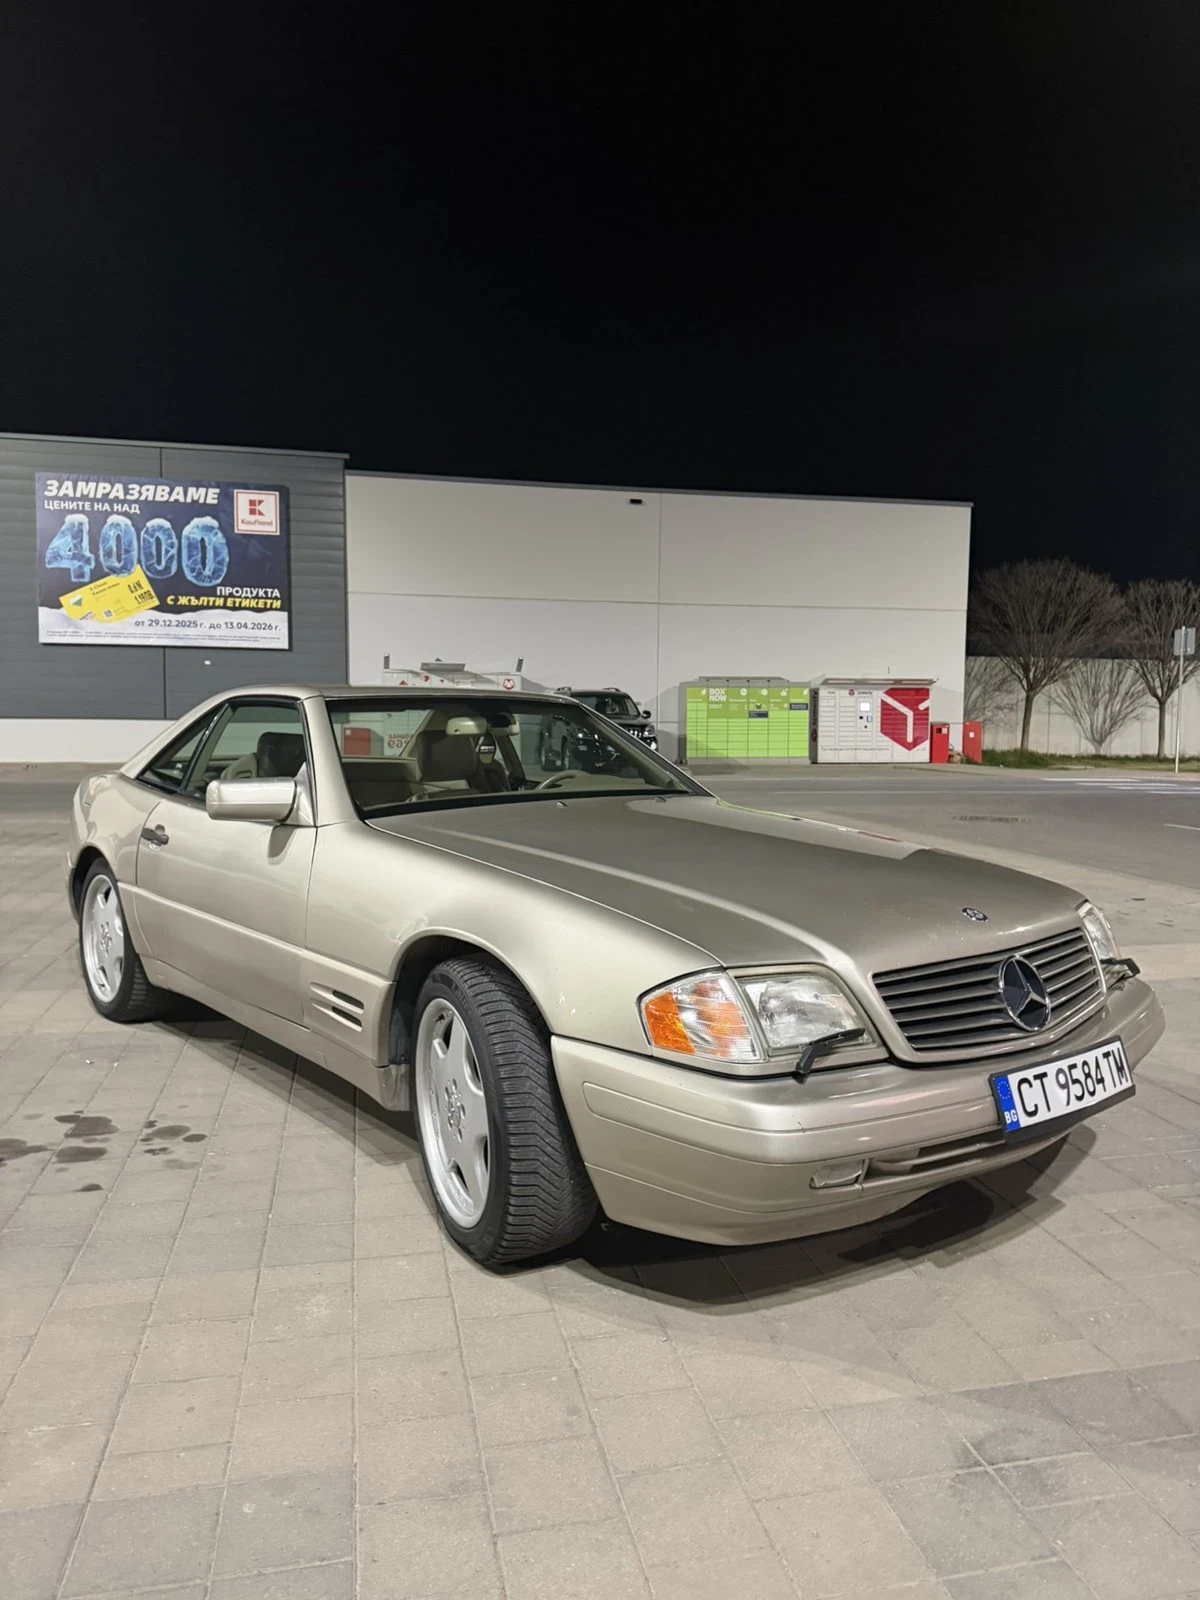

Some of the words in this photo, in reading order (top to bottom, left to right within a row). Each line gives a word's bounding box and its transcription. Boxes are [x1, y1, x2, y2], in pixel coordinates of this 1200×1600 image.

[44, 480, 220, 504] ЗАМРАЗЯВАМЕ
[44, 500, 92, 512] ЦЕНИТЕ
[94, 502, 111, 512] НА
[113, 503, 140, 514] НАД
[46, 514, 229, 586] 4000
[216, 586, 281, 598] ПРОДУКТА
[167, 595, 174, 605] С
[177, 596, 221, 607] ЖЪЛТИ
[226, 597, 281, 609] ЕТИКЕТИ
[135, 620, 146, 628] от
[148, 619, 198, 630] 29.12.2025
[208, 622, 222, 631] до
[224, 621, 273, 632] 13.04.2026
[708, 688, 727, 697] BOX
[708, 695, 728, 703] NOW
[1017, 1072, 1051, 1118] CT
[1055, 1056, 1106, 1106] 9584
[1103, 1048, 1128, 1088] TM
[1004, 1109, 1018, 1124] BG
